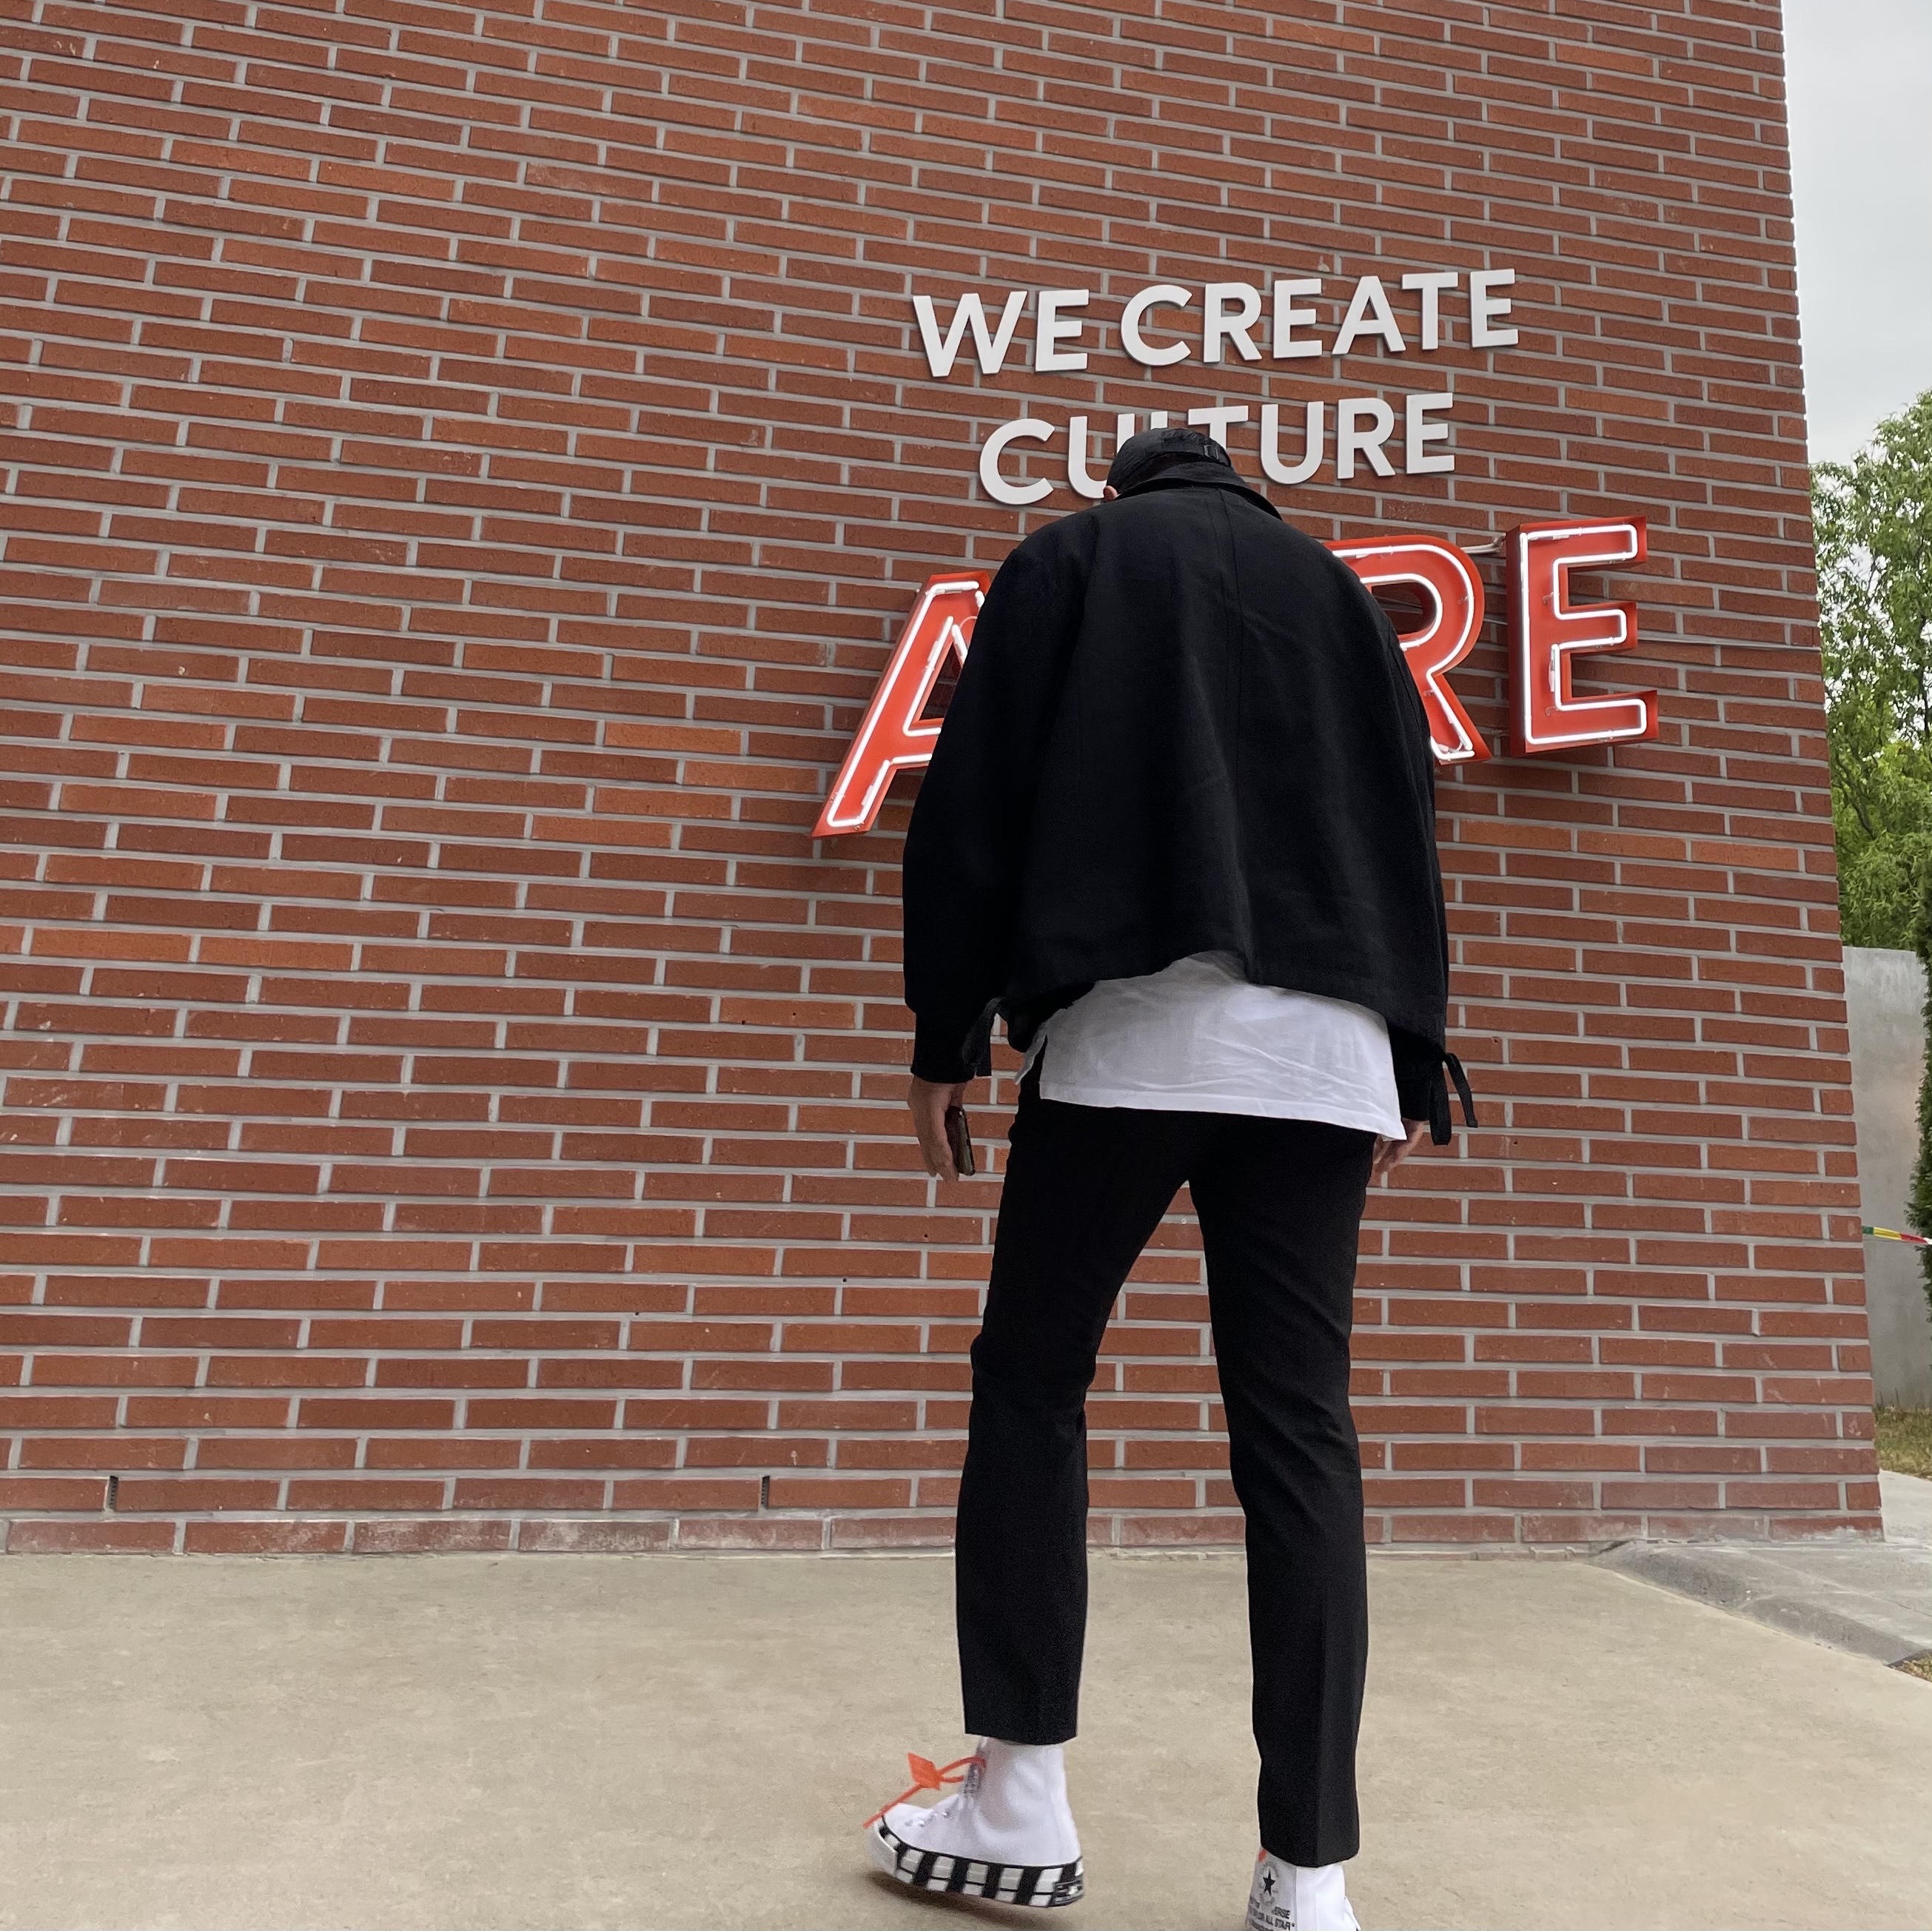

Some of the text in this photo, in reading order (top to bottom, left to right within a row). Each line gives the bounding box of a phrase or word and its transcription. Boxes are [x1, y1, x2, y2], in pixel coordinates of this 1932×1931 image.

[913, 269, 1519, 377] WE CREATE
[979, 392, 1455, 506] CUTURE
